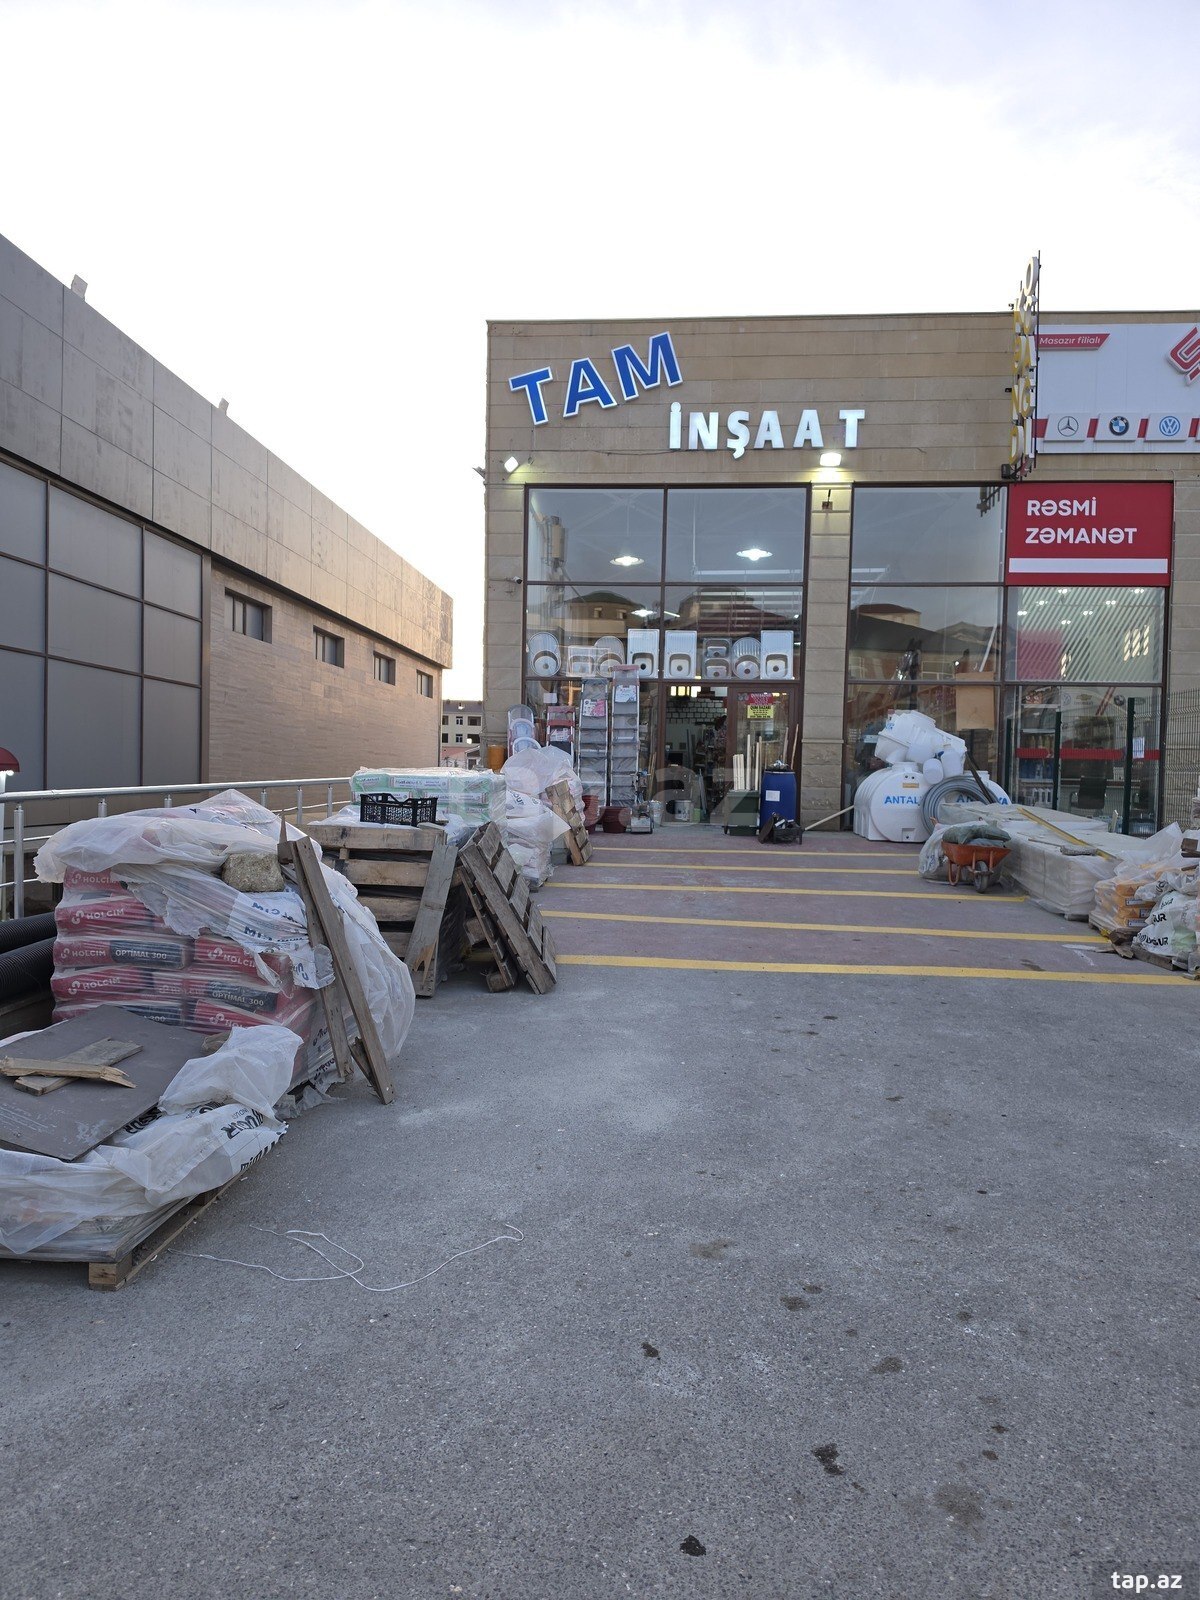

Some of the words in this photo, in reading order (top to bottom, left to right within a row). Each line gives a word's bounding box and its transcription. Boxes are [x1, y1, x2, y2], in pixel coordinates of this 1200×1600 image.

[1039, 336, 1075, 345] Masazır
[508, 331, 684, 426] TAM
[669, 401, 866, 460] İNŞAAT
[1026, 496, 1098, 516] RƏSMİ
[1024, 527, 1138, 545] ZƏMANƏT
[71, 949, 107, 958] HOLCIM
[152, 952, 168, 960] 300
[82, 976, 121, 990] HOLCIM
[248, 997, 265, 1007] 300
